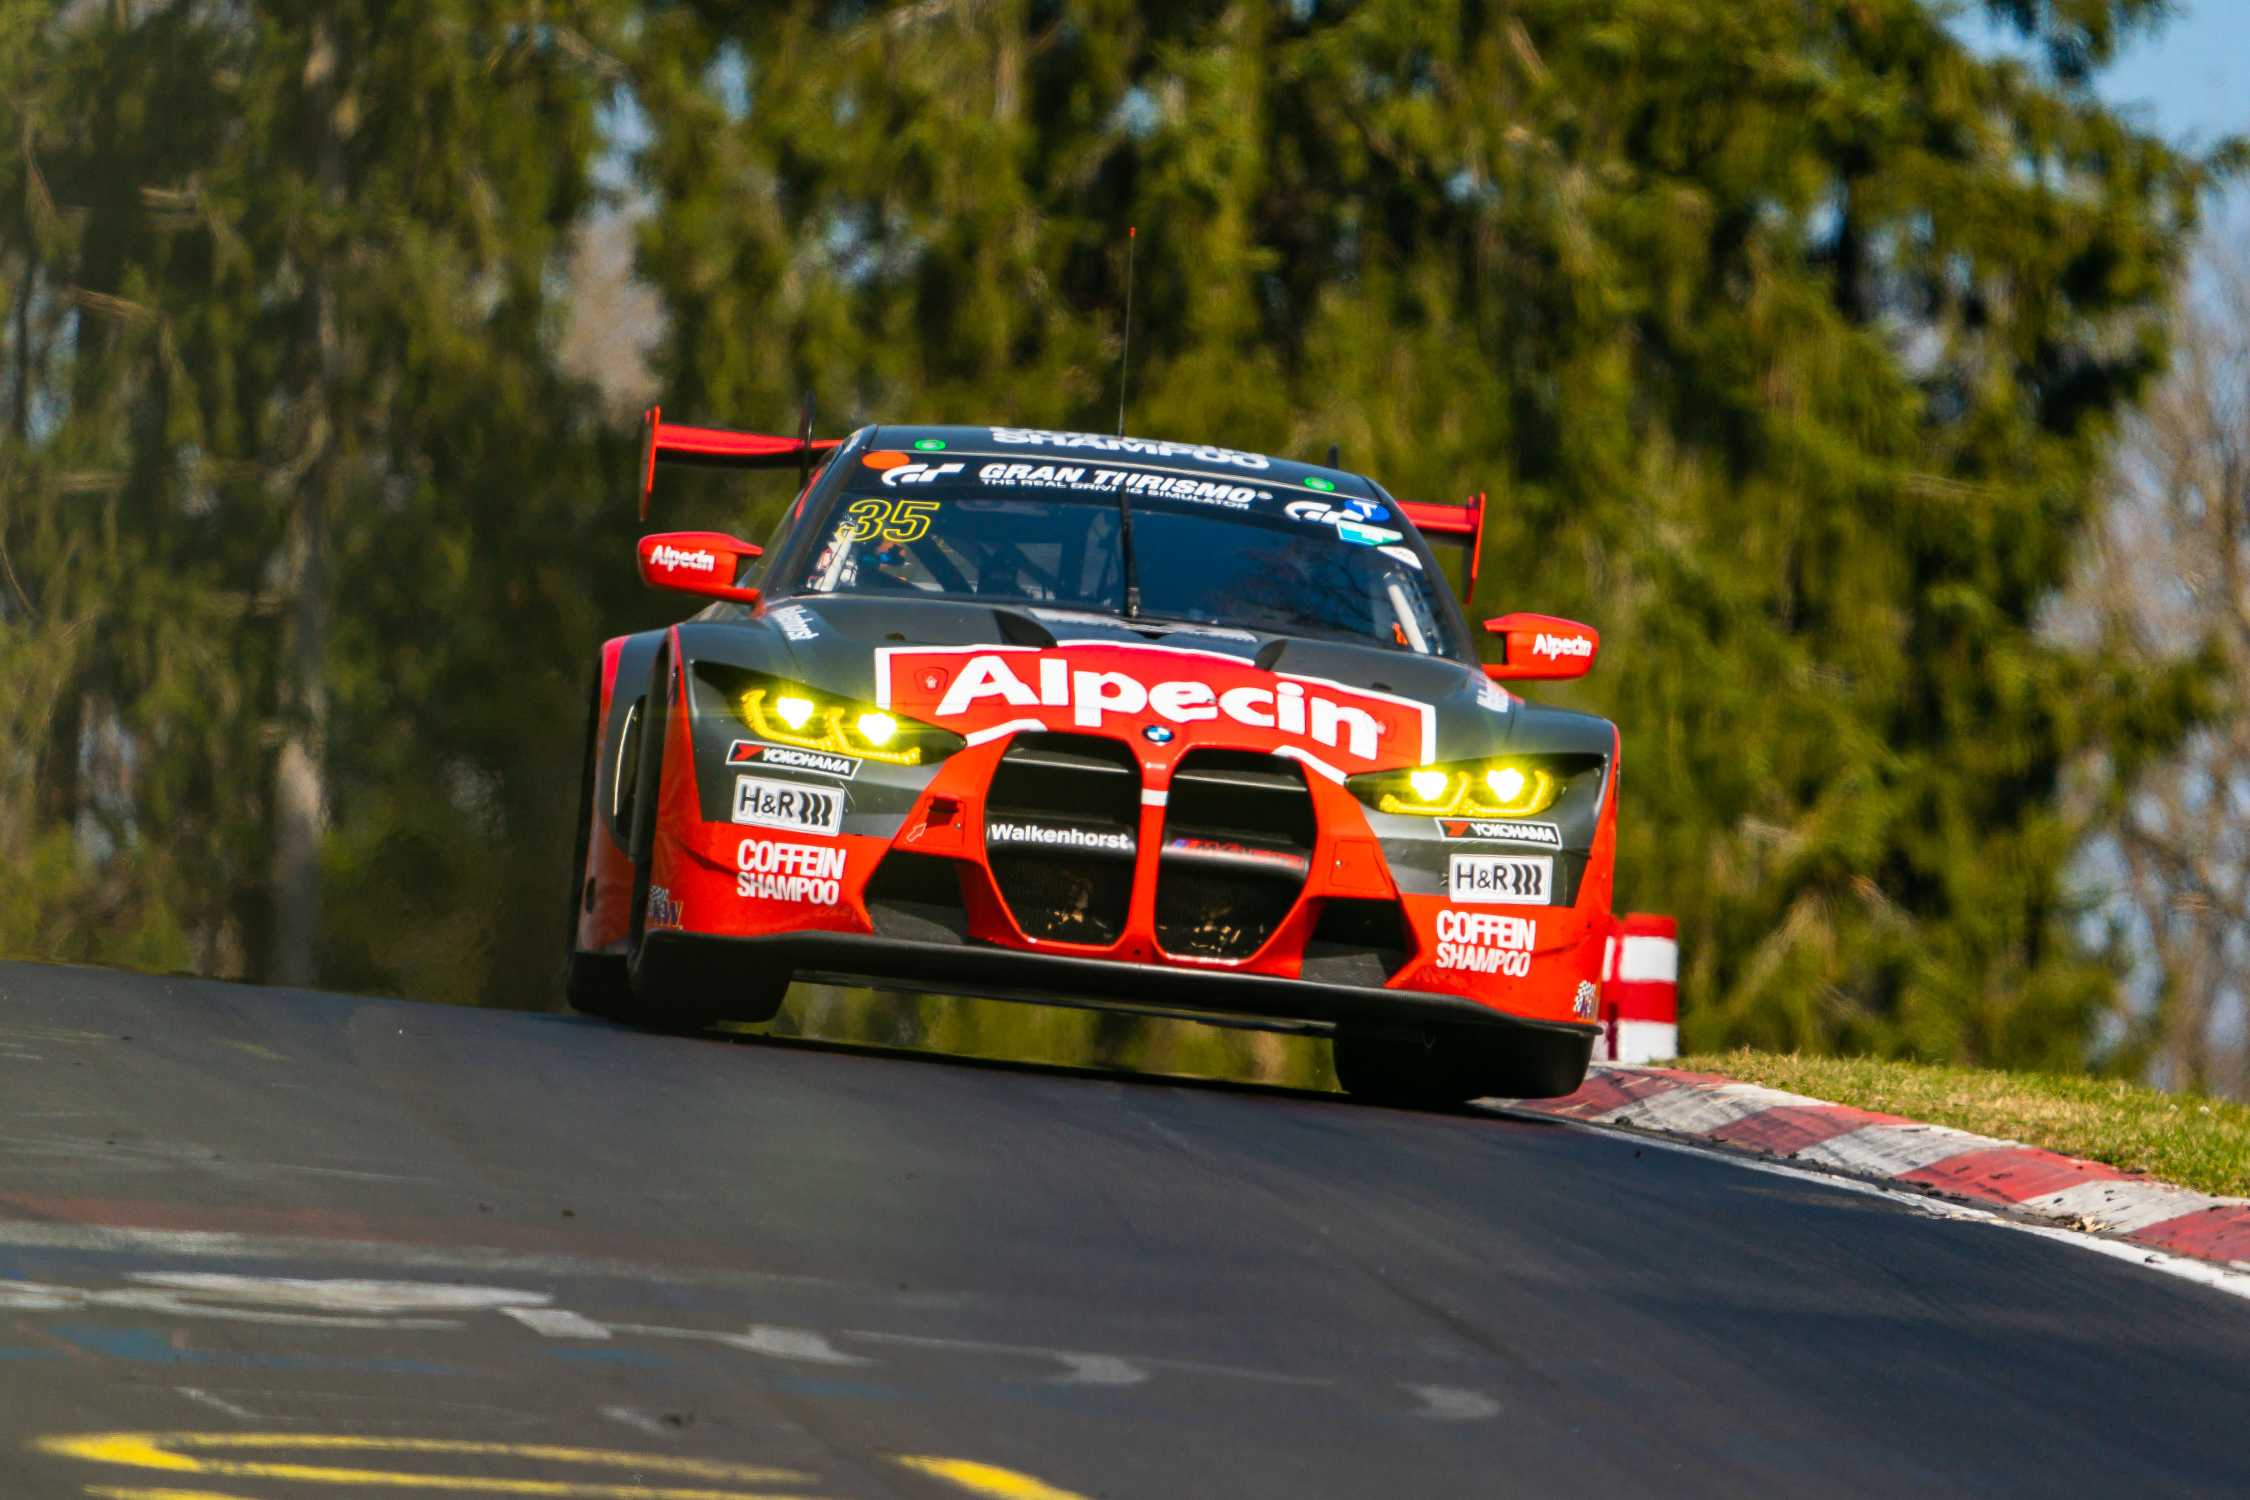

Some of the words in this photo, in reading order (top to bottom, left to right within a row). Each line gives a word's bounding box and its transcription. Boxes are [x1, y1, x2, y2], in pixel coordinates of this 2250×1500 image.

[978, 463, 1085, 483] GRAN
[981, 478, 1015, 486] THE
[1020, 480, 1067, 489] REAL
[1147, 489, 1250, 511] SIMULATOR
[848, 498, 940, 543] 35
[650, 545, 715, 572] Alpecin
[1533, 633, 1592, 661] Alpecin
[936, 655, 1383, 761] Alpecin
[762, 747, 850, 775] YOKOHAMA
[740, 783, 795, 818] H&R
[990, 823, 1129, 850] Walkenhorst
[1470, 822, 1557, 843] YOKOHAMA
[737, 838, 847, 880] COFFEIN
[736, 871, 840, 905] SHAMPOO
[1456, 863, 1509, 891] H&R
[1436, 909, 1536, 951] COFFEIN
[1435, 942, 1532, 978] SHAMPOO
